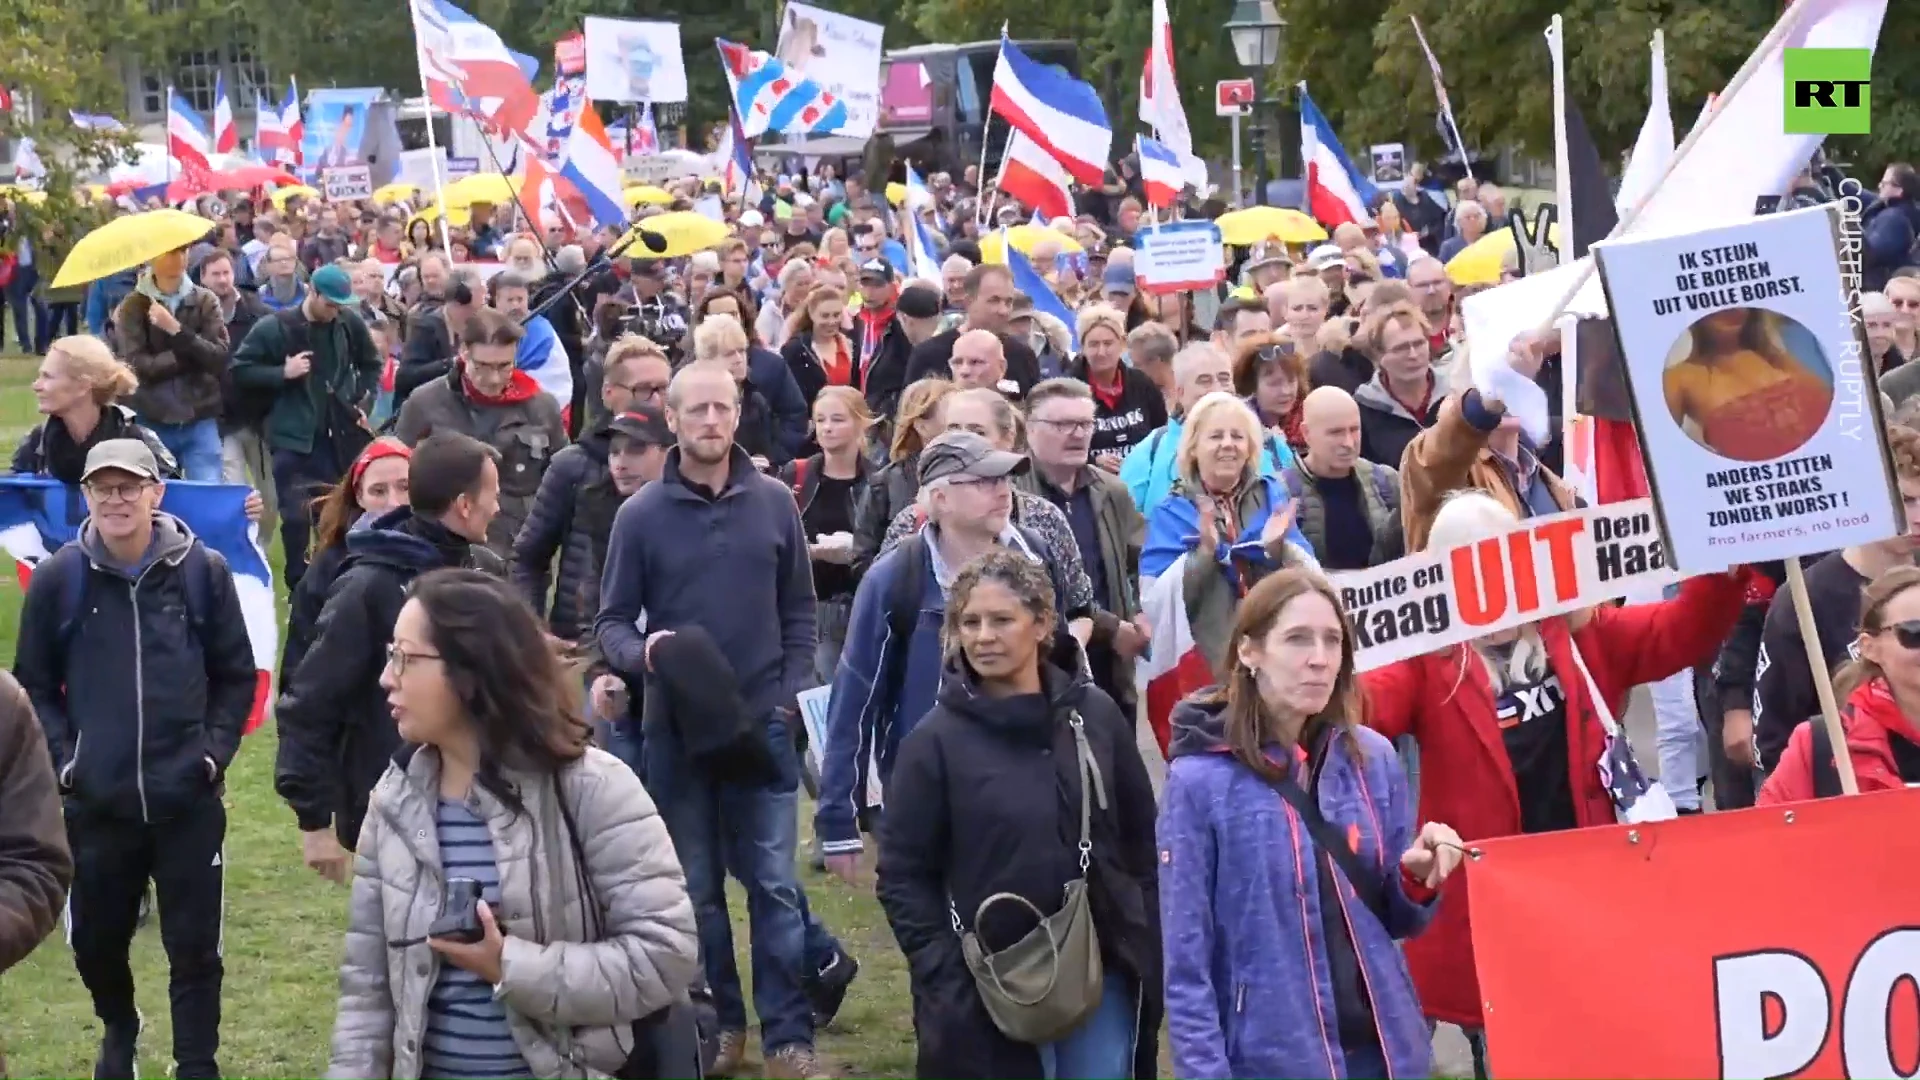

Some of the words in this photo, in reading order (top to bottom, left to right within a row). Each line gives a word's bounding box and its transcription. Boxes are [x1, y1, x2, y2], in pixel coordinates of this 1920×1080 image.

[1678, 252, 1699, 271] IK
[1701, 241, 1759, 267] STEUN
[1676, 272, 1698, 292] DE
[1701, 261, 1771, 288] BOEREN
[1652, 296, 1682, 316] UIT
[1686, 286, 1739, 311] VOLLE
[1740, 275, 1805, 302] BORST.
[1706, 463, 1772, 488] ANDERS
[1775, 453, 1833, 479] ZITTEN
[1724, 487, 1753, 506] WE
[1755, 475, 1822, 502] STRAKS
[1593, 512, 1650, 543] Den
[1706, 505, 1773, 528] ZONDER
[1775, 492, 1839, 518] WORST
[1707, 534, 1737, 547] #no
[1740, 525, 1807, 544] farmers,
[1811, 520, 1832, 533] no
[1836, 512, 1870, 529] food
[1450, 516, 1585, 627] UIT
[1596, 541, 1665, 582] Haa
[1341, 575, 1407, 611] Rutte
[1412, 563, 1444, 589] en
[1345, 592, 1450, 651] Kaag
